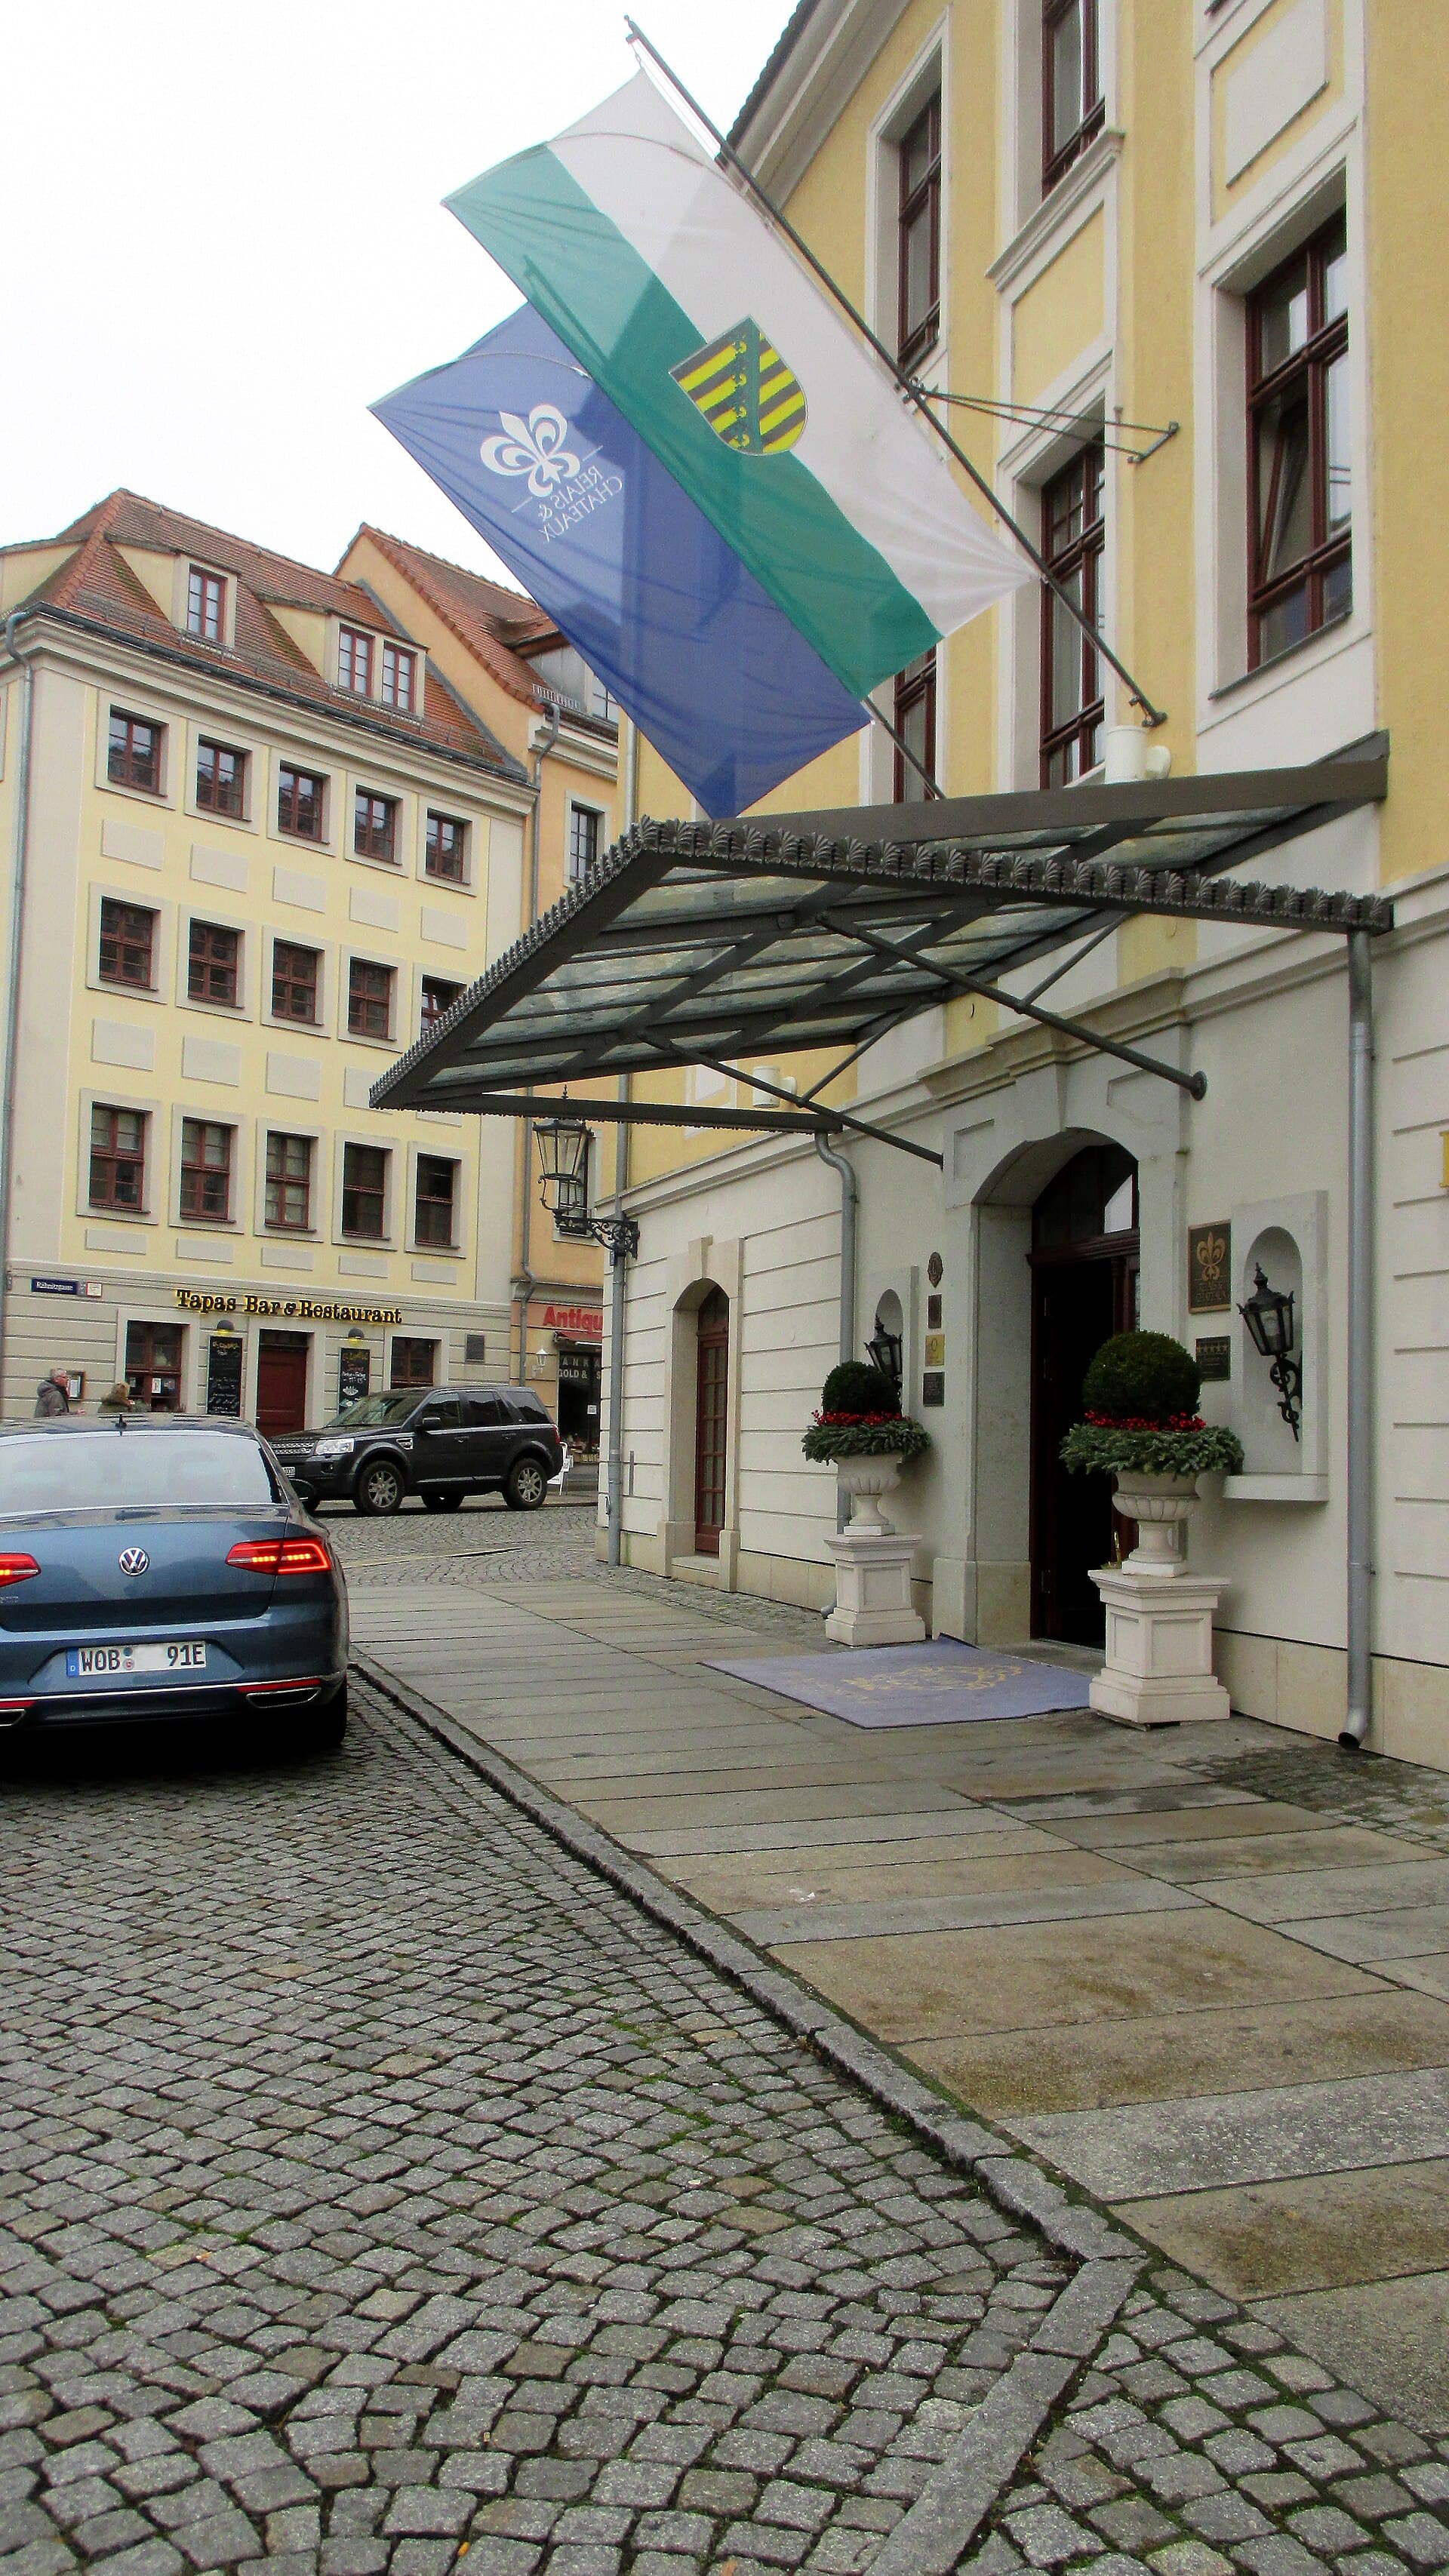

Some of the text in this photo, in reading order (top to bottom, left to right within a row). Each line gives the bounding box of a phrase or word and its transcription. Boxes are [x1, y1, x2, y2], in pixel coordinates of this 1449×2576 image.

[176, 1289, 402, 1324] Tapas Bar & Restaurant
[81, 1643, 205, 1672] WOB 91E
